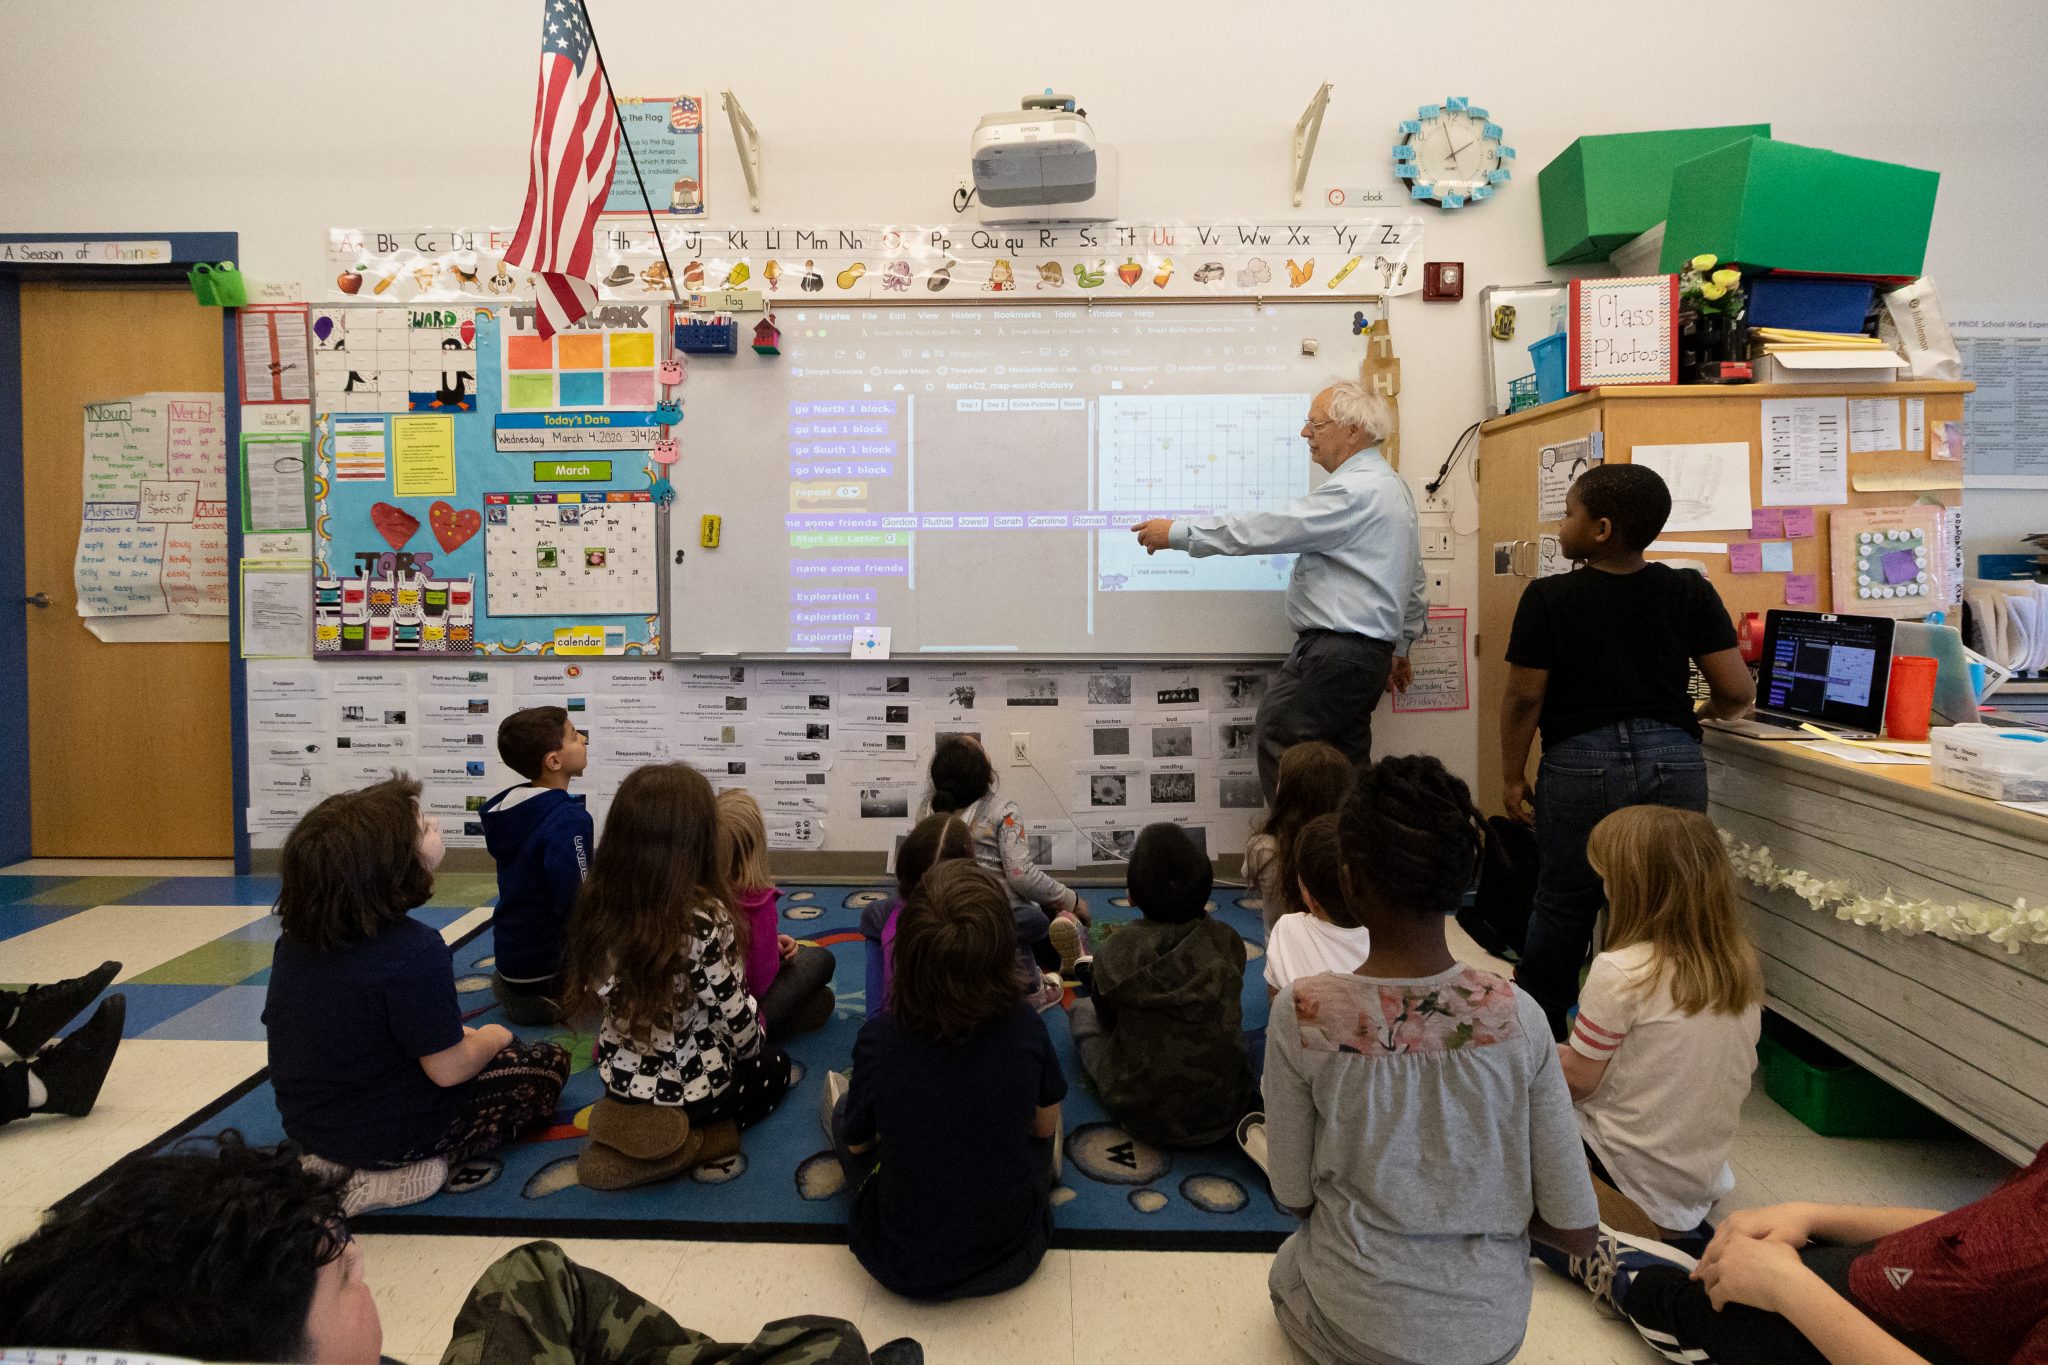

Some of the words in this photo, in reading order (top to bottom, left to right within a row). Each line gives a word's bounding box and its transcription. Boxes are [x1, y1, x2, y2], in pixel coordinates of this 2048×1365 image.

[645, 114, 663, 122] Flag
[1488, 151, 1493, 159] 3
[1363, 192, 1383, 201] clock
[377, 233, 399, 252] Bb
[414, 233, 436, 252] Cc
[452, 232, 473, 250] Dd
[608, 232, 630, 249] Hh
[686, 231, 702, 258] Jj
[729, 231, 748, 249] Kk
[796, 231, 828, 249] Mm
[840, 231, 862, 249] Nn
[931, 231, 951, 258] Pp
[971, 231, 998, 249] Qu
[1005, 237, 1023, 256] qu
[1040, 229, 1058, 247] Rr
[1080, 228, 1098, 247] Ss
[1115, 227, 1136, 246] Tt
[1153, 226, 1174, 246] Uu
[1197, 226, 1220, 245] Vv
[1237, 226, 1271, 245] Ww
[1287, 226, 1310, 245] Xx
[1333, 225, 1357, 254] Yy
[1381, 225, 1400, 245] Zz
[4, 246, 13, 258] A
[20, 246, 63, 260] Season
[76, 244, 90, 260] of
[104, 244, 160, 260] Chane
[725, 295, 744, 309] flag
[951, 312, 982, 320] History
[1599, 294, 1653, 328] Class
[413, 311, 457, 327] WARD
[510, 306, 648, 330] TWORK
[1912, 311, 1928, 351] lululemon
[1594, 339, 1658, 366] Photos
[1373, 373, 1393, 396] H
[90, 406, 127, 420] Noun
[172, 404, 207, 419] Verb
[544, 415, 581, 425] Today's
[585, 415, 610, 424] Date
[853, 425, 882, 433] block
[497, 432, 544, 447] Wednesday
[552, 432, 583, 443] March
[796, 447, 809, 455] go
[556, 466, 590, 475] March
[144, 488, 170, 502] Parts
[86, 505, 135, 519] Adjective
[147, 505, 183, 516] Speech
[960, 518, 987, 526] Jowell
[354, 552, 433, 578] JOBS
[865, 564, 903, 572] friends
[797, 593, 859, 602] Exploration
[797, 614, 859, 622] Exploration
[558, 636, 601, 646] calendar
[1414, 668, 1449, 676] ednesday
